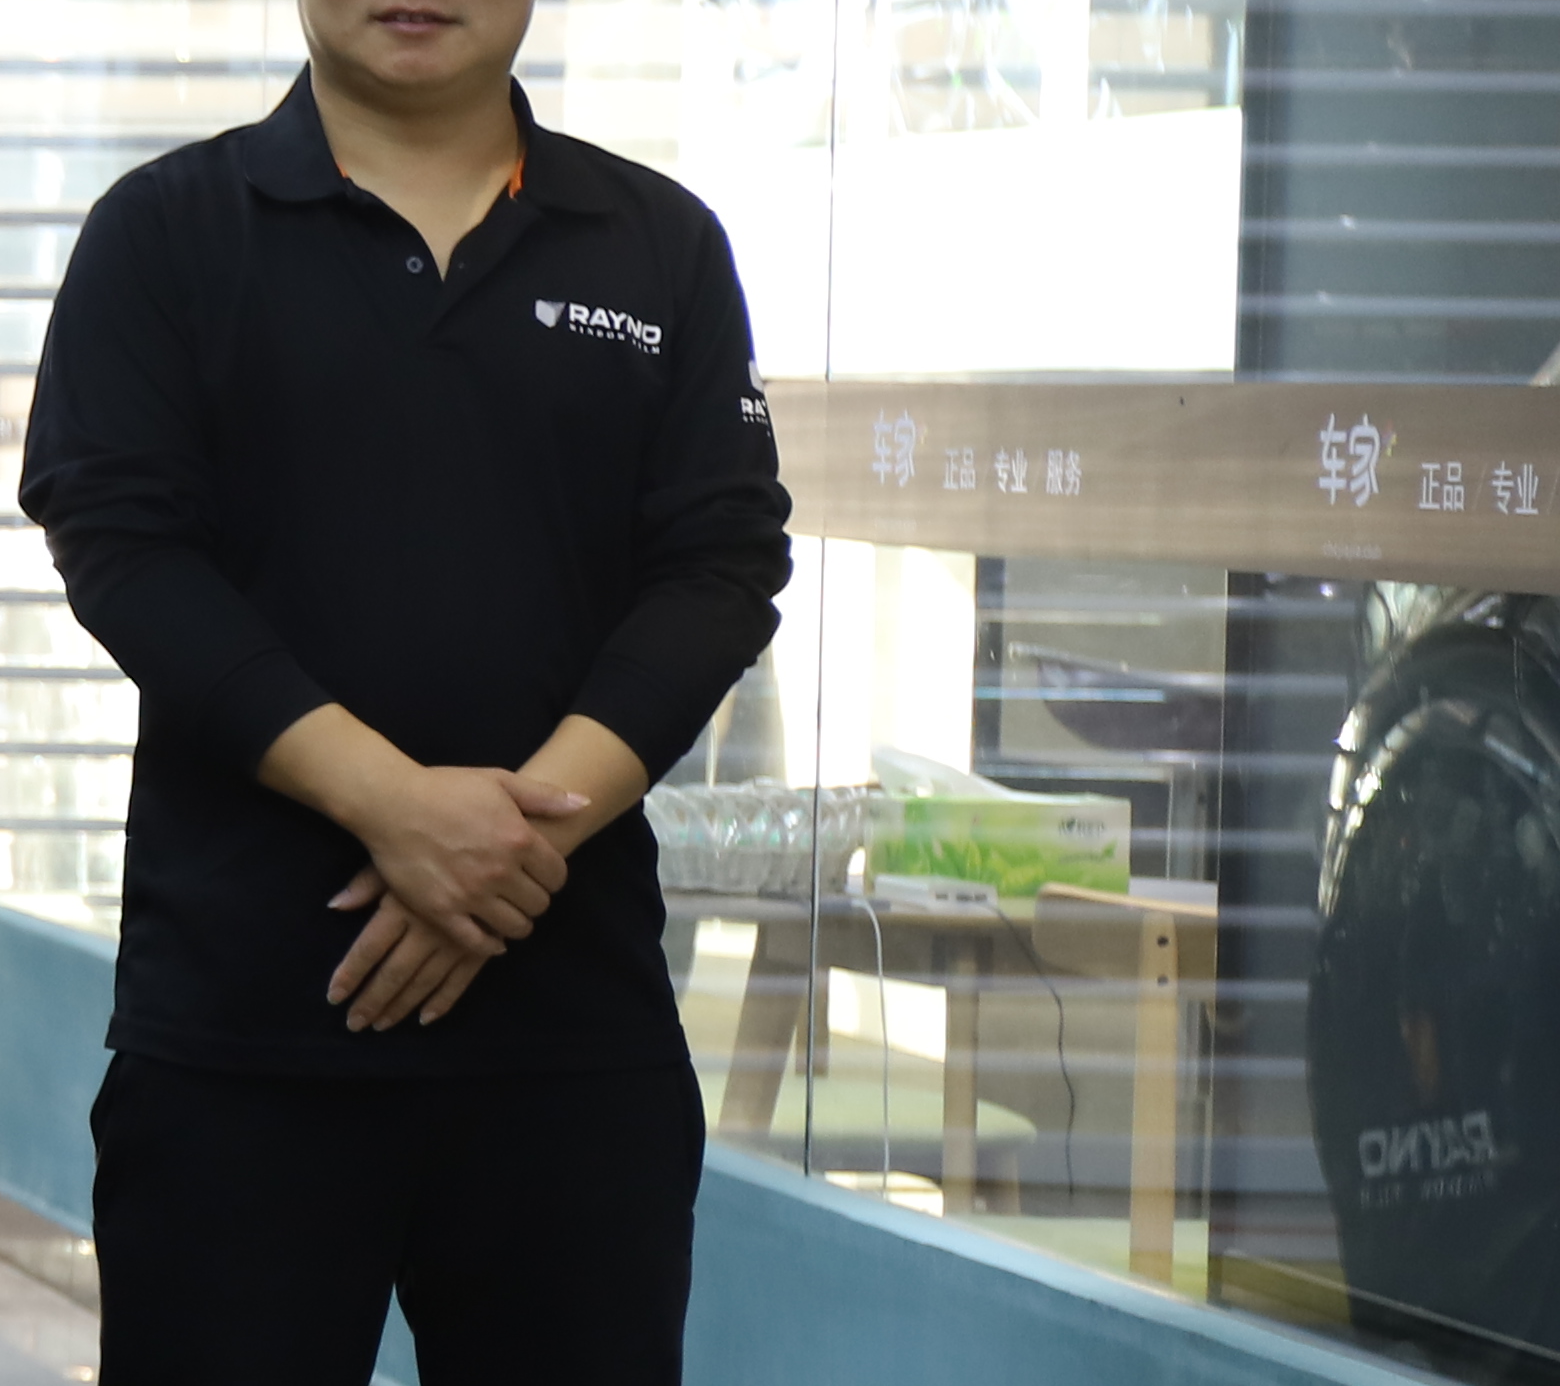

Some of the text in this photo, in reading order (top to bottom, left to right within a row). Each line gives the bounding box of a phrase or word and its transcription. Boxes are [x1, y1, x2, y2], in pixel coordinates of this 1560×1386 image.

[568, 301, 662, 346] RAYNO
[942, 445, 1082, 496] 正品 专业 服务
[1419, 460, 1539, 515] 正品 专业
